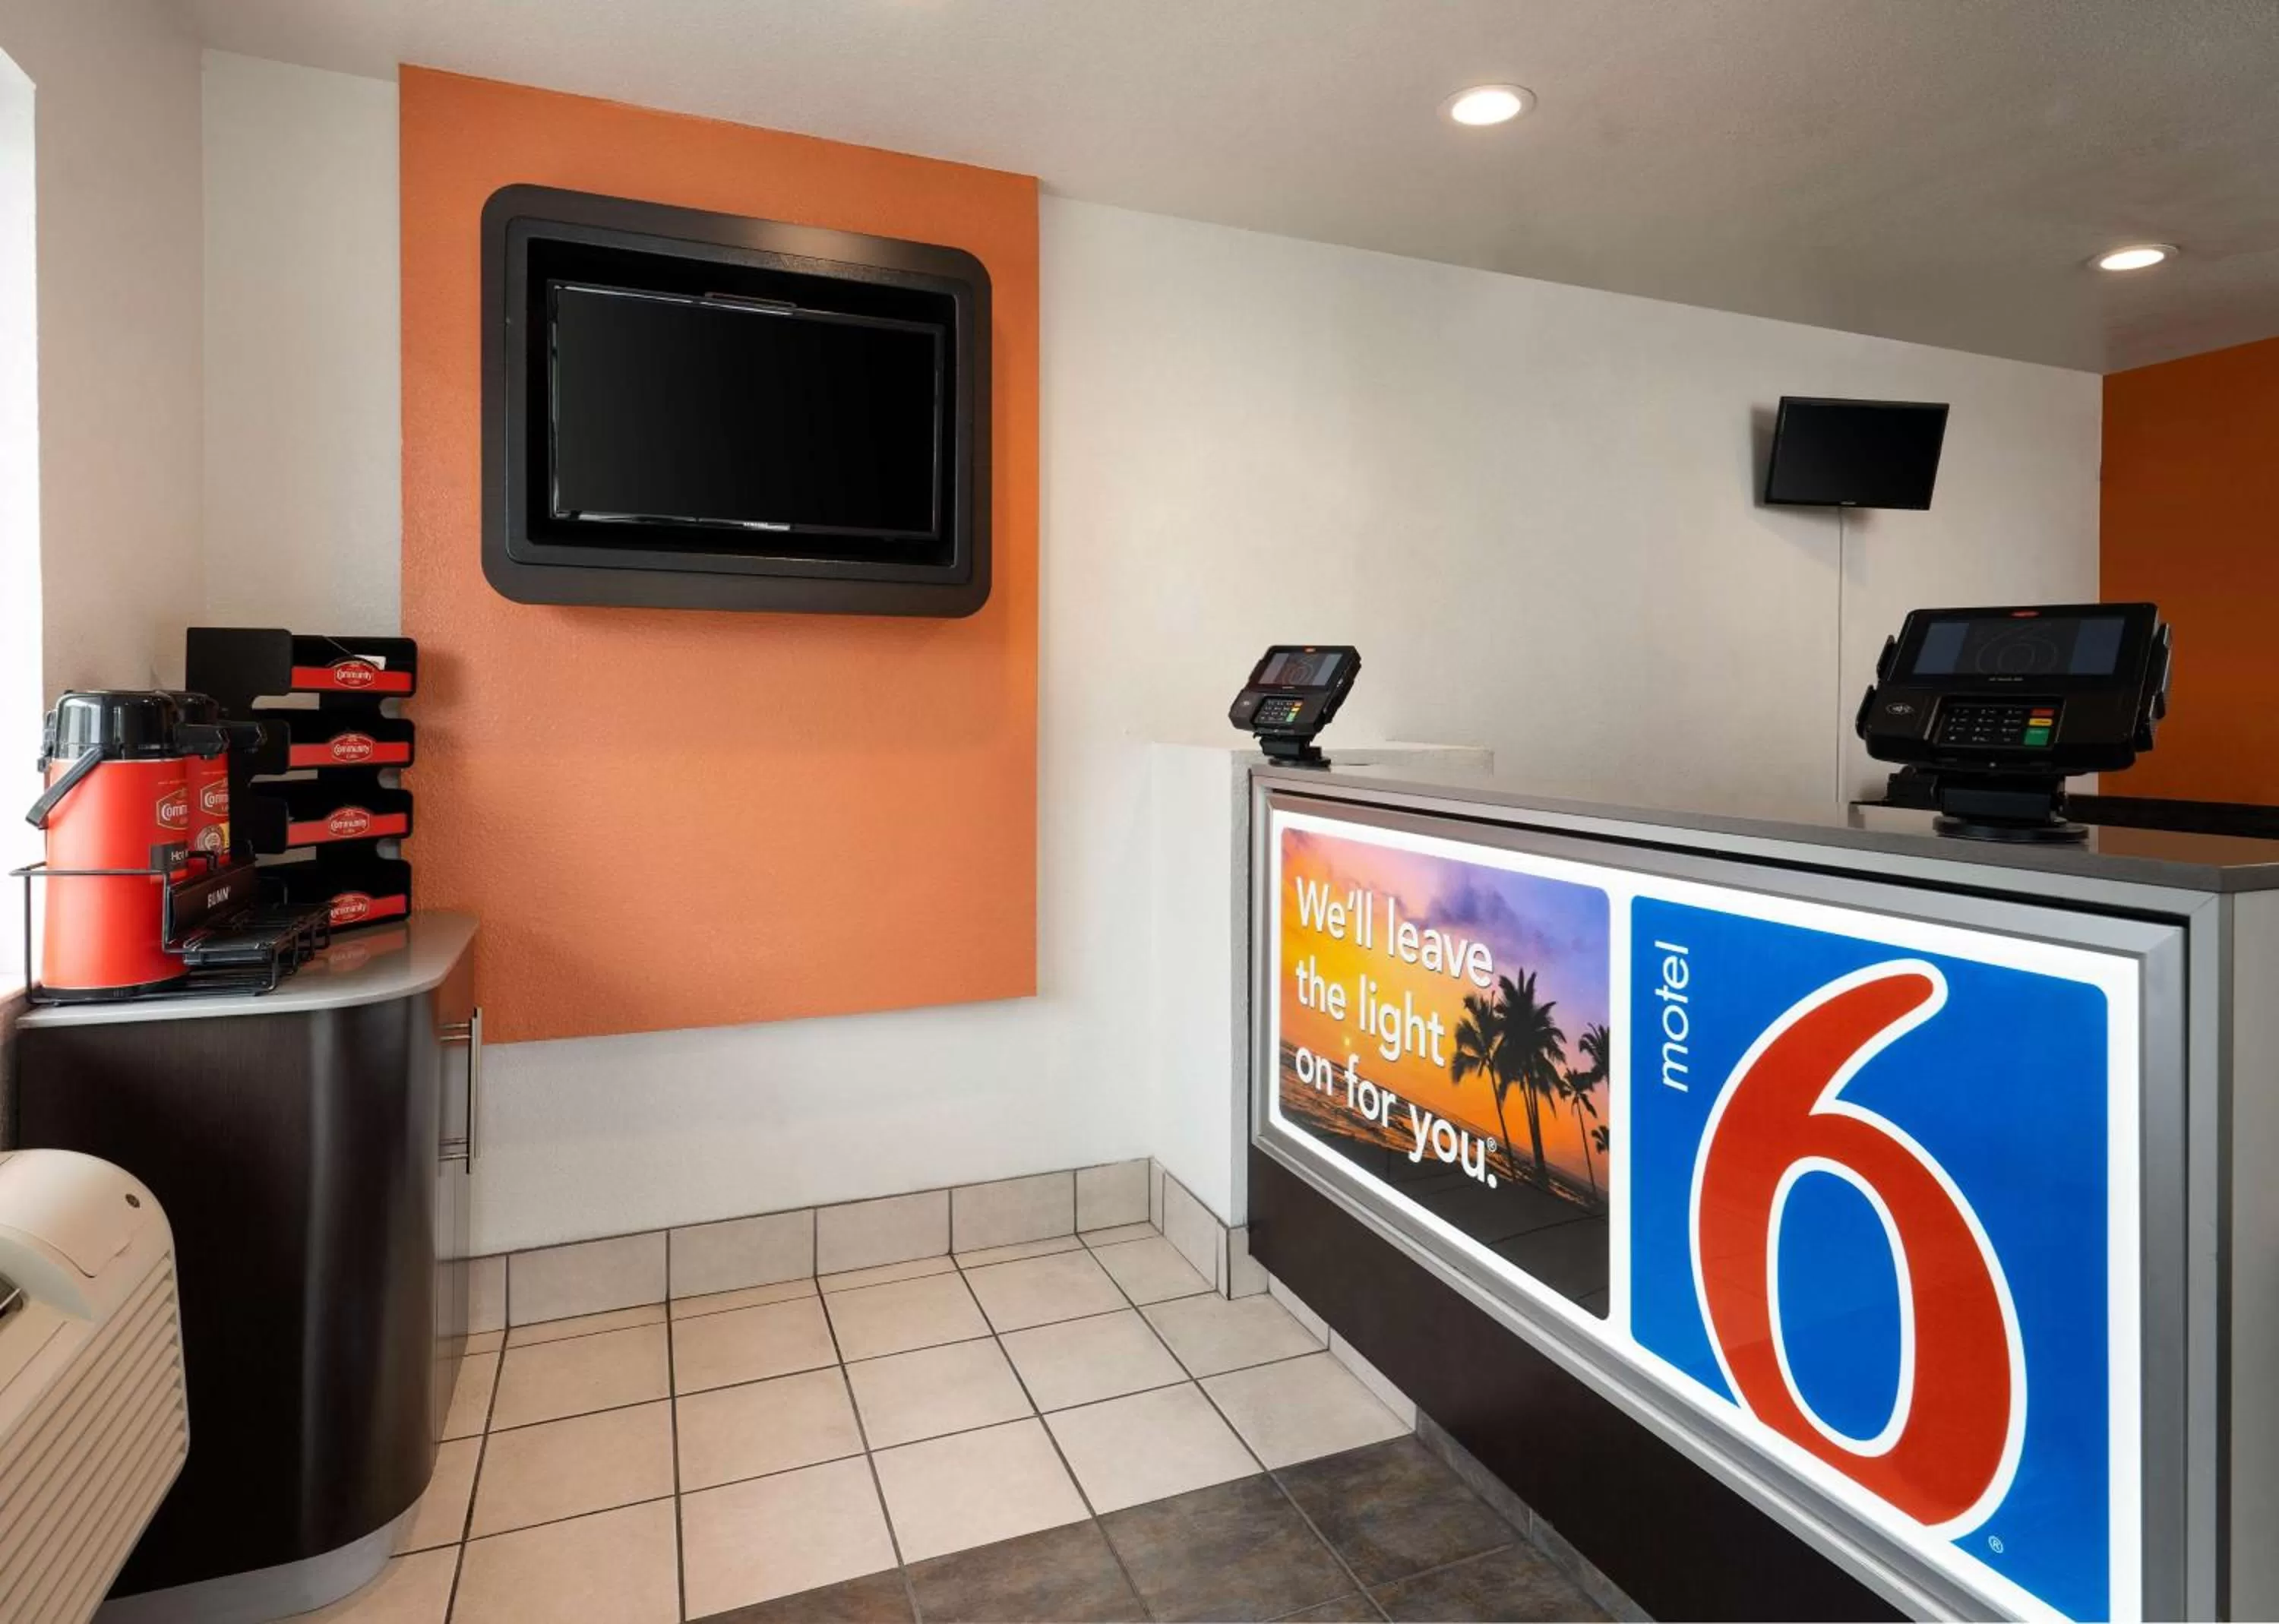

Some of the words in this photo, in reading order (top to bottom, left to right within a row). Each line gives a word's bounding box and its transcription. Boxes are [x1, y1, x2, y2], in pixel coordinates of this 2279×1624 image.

[1296, 876, 1373, 949] We'll
[1388, 897, 1494, 987] leave
[1295, 955, 1346, 1020] the
[1359, 974, 1445, 1066] light
[1654, 940, 1689, 1093] motel
[1295, 1047, 1332, 1095] on
[1343, 1054, 1396, 1127] for
[1690, 959, 2026, 1540] 6
